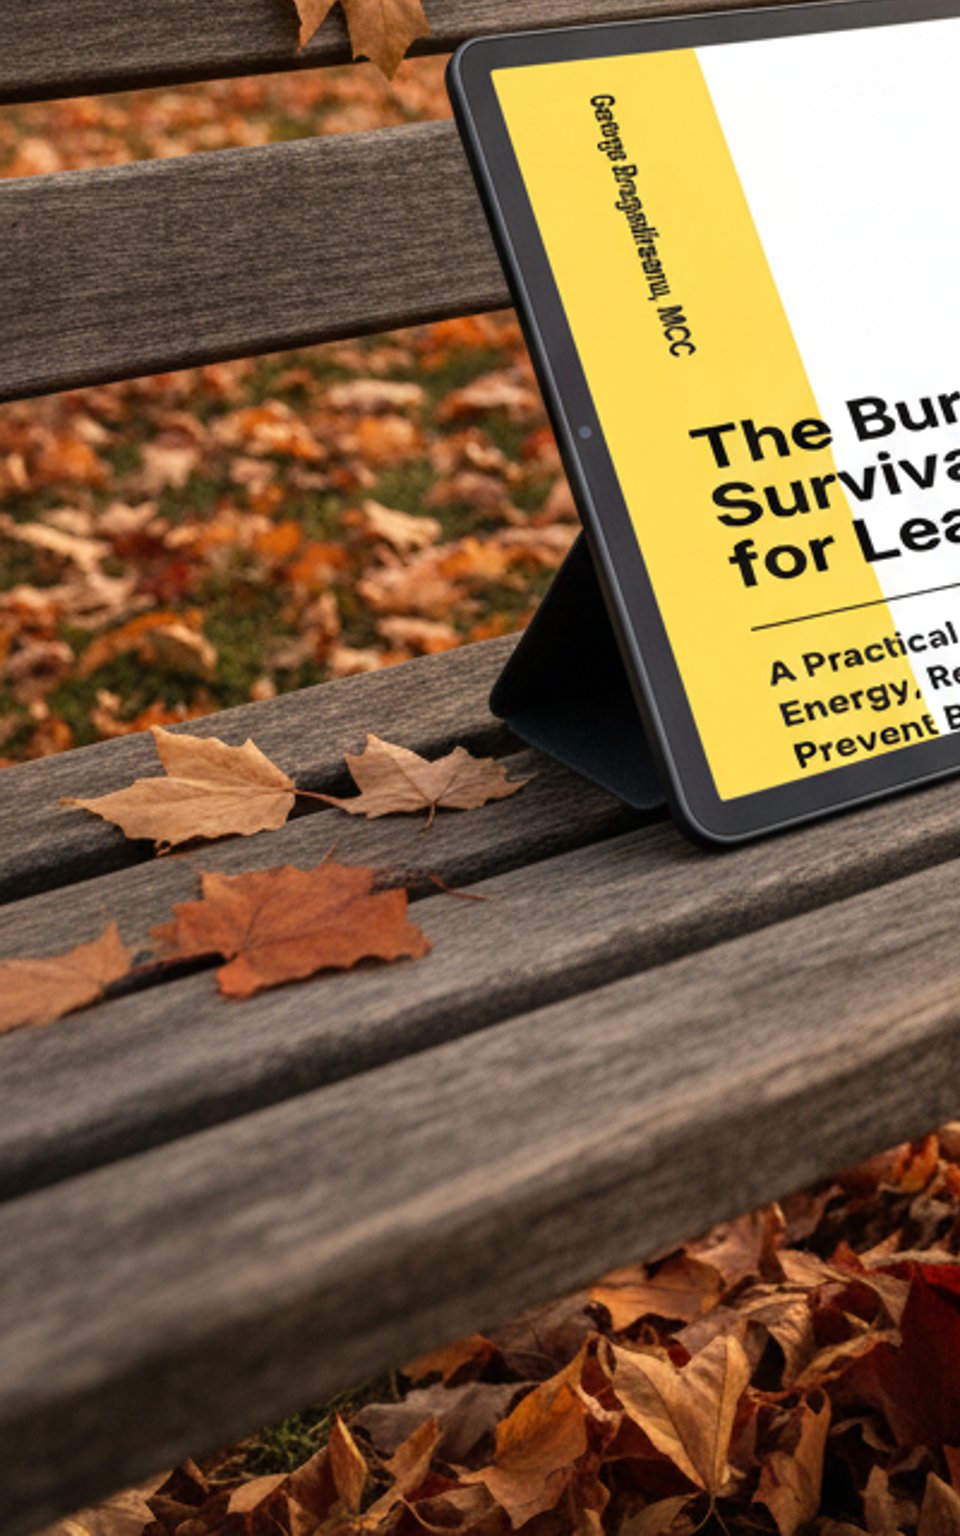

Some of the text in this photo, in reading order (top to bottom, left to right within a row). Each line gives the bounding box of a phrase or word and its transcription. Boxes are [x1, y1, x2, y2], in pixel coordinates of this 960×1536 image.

[657, 305, 697, 357] MCC
[688, 418, 833, 469] The
[727, 534, 834, 588] for
[769, 660, 798, 687] A
[801, 620, 958, 677] Practical
[778, 679, 922, 727] Energy,
[792, 713, 940, 769] Prevent
